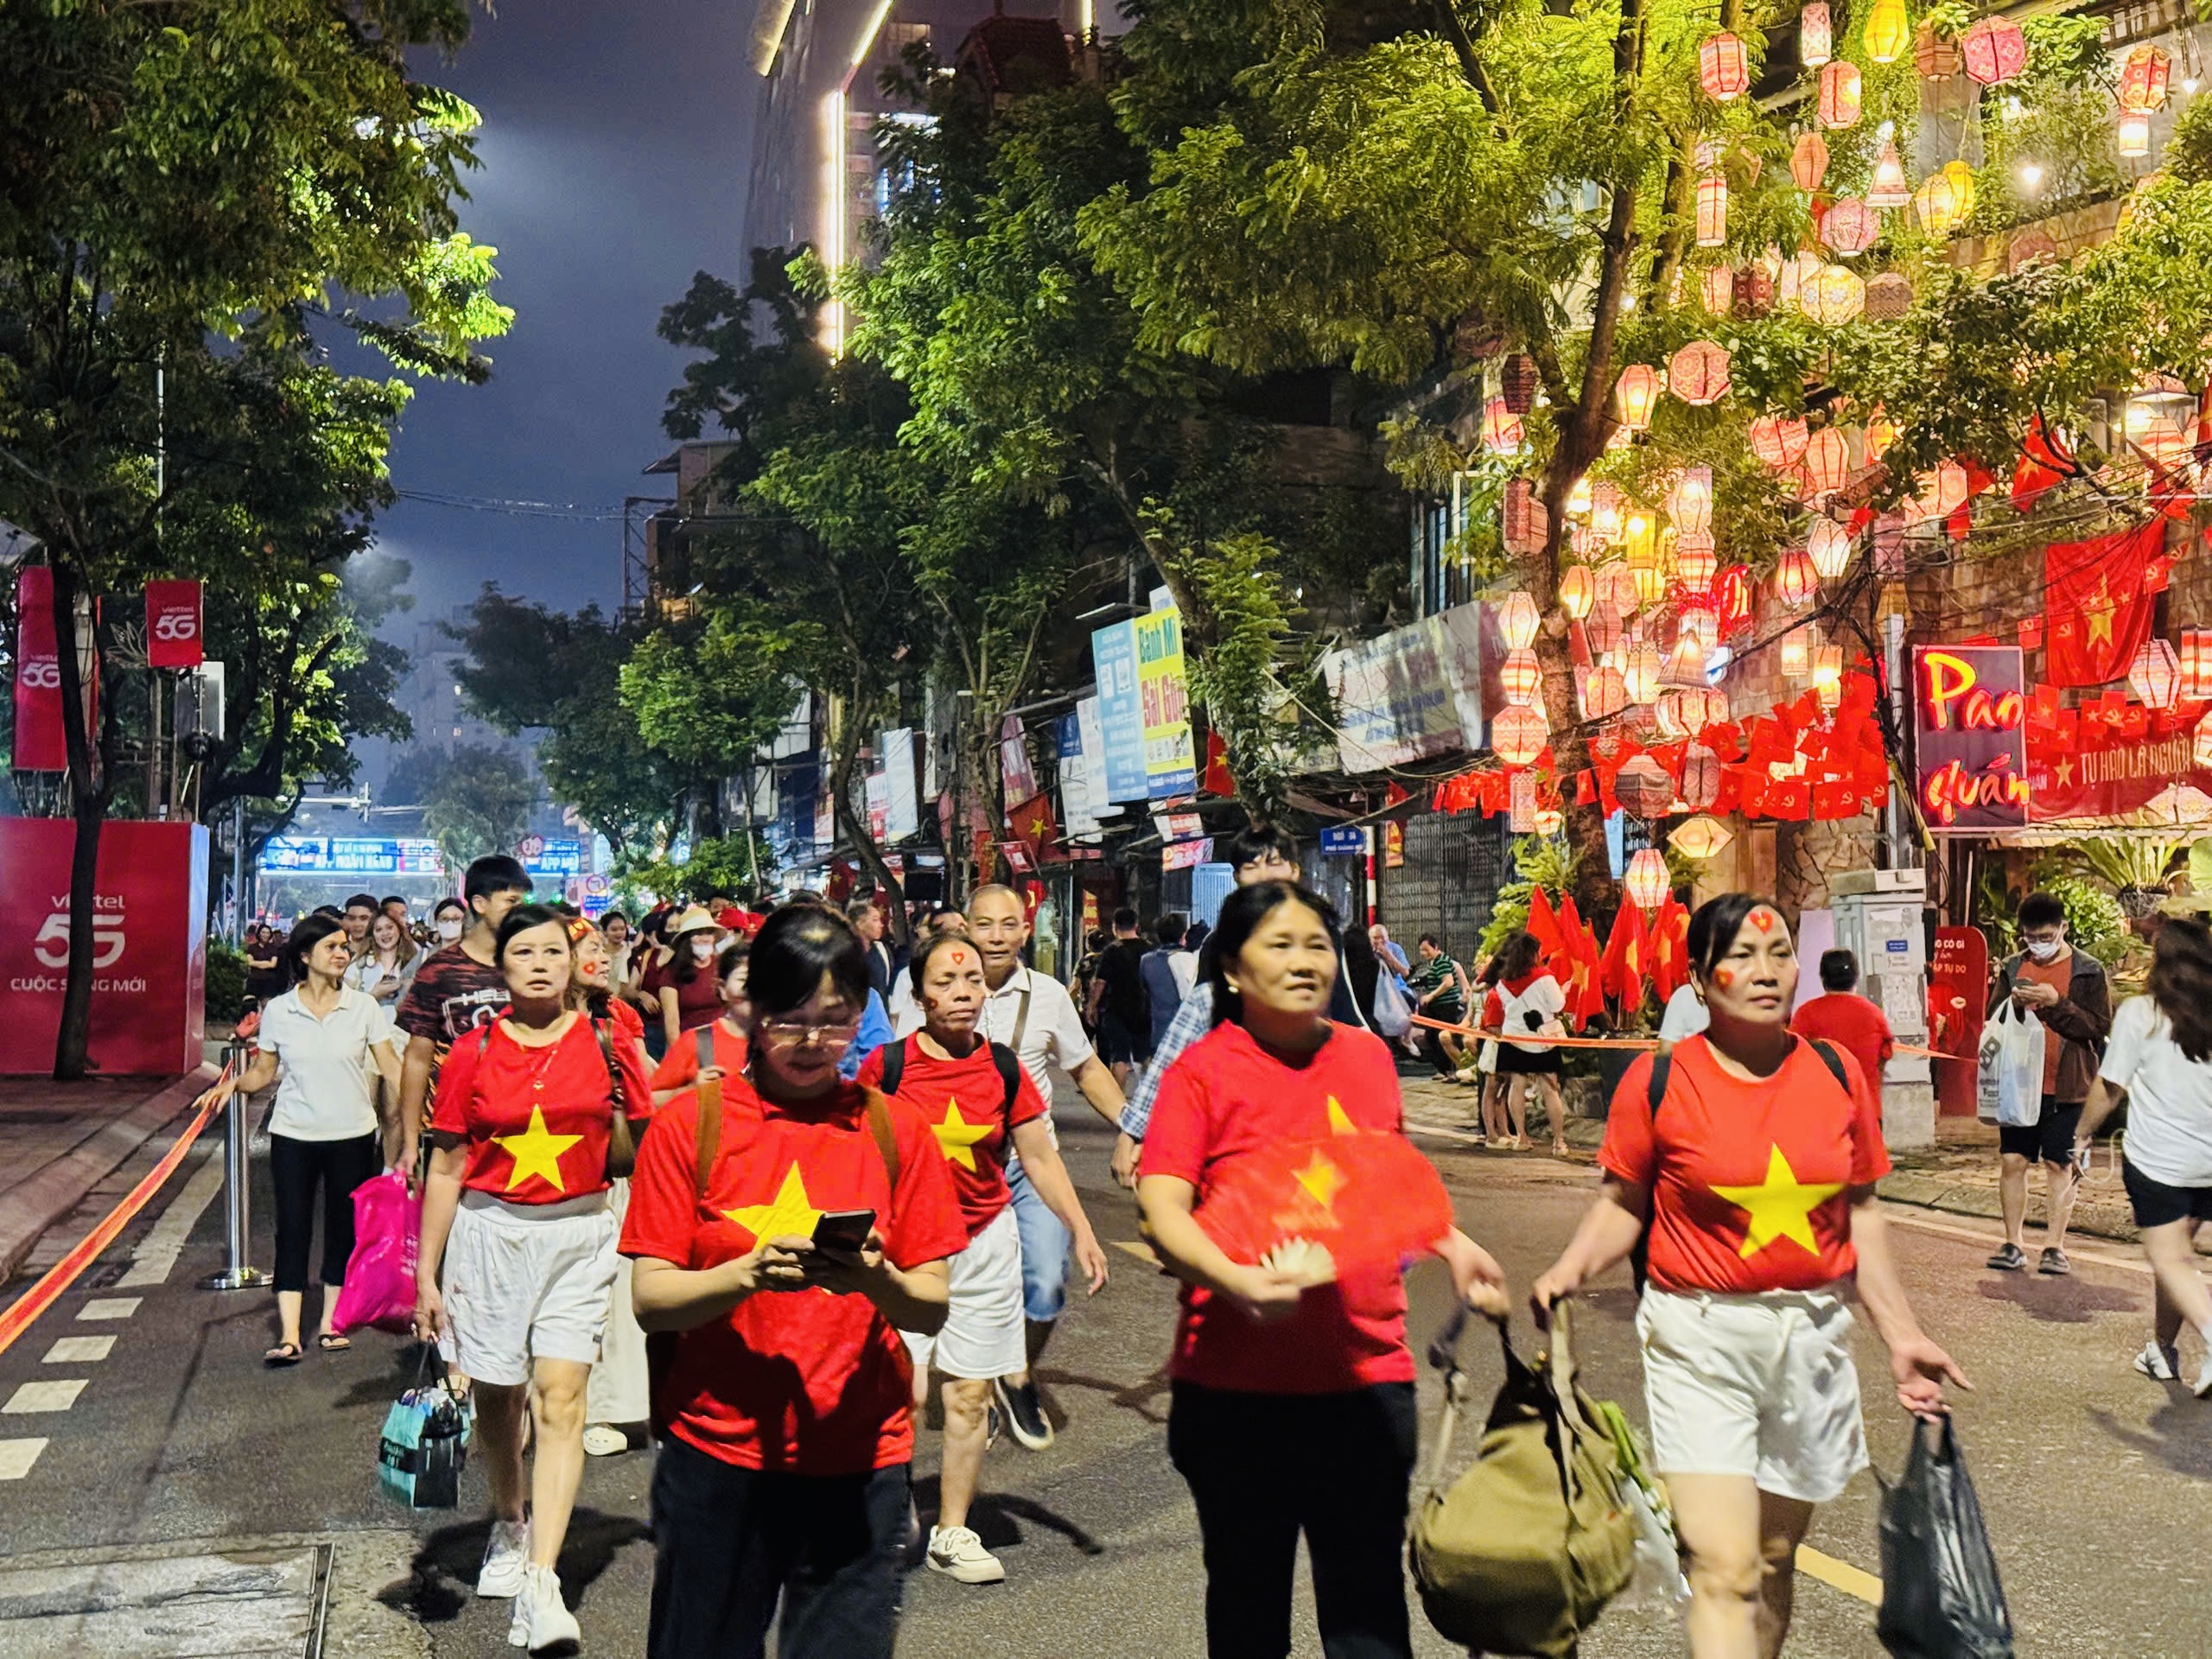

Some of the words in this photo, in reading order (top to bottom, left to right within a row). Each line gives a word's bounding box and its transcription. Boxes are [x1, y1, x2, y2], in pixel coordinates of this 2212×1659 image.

[156, 614, 196, 639] 5G
[1138, 623, 1163, 664] Bánh
[22, 662, 60, 688] 5G
[1923, 652, 2025, 730] Pao
[1141, 677, 1162, 728] Sài
[2080, 752, 2097, 790] TỰ
[2100, 741, 2126, 783] HÀO
[2128, 738, 2147, 779] LÀ
[2149, 732, 2190, 776] NGƯỜI
[10, 975, 57, 993] CUỘC
[113, 976, 146, 993] MỚI
[1955, 964, 1967, 974] DO
